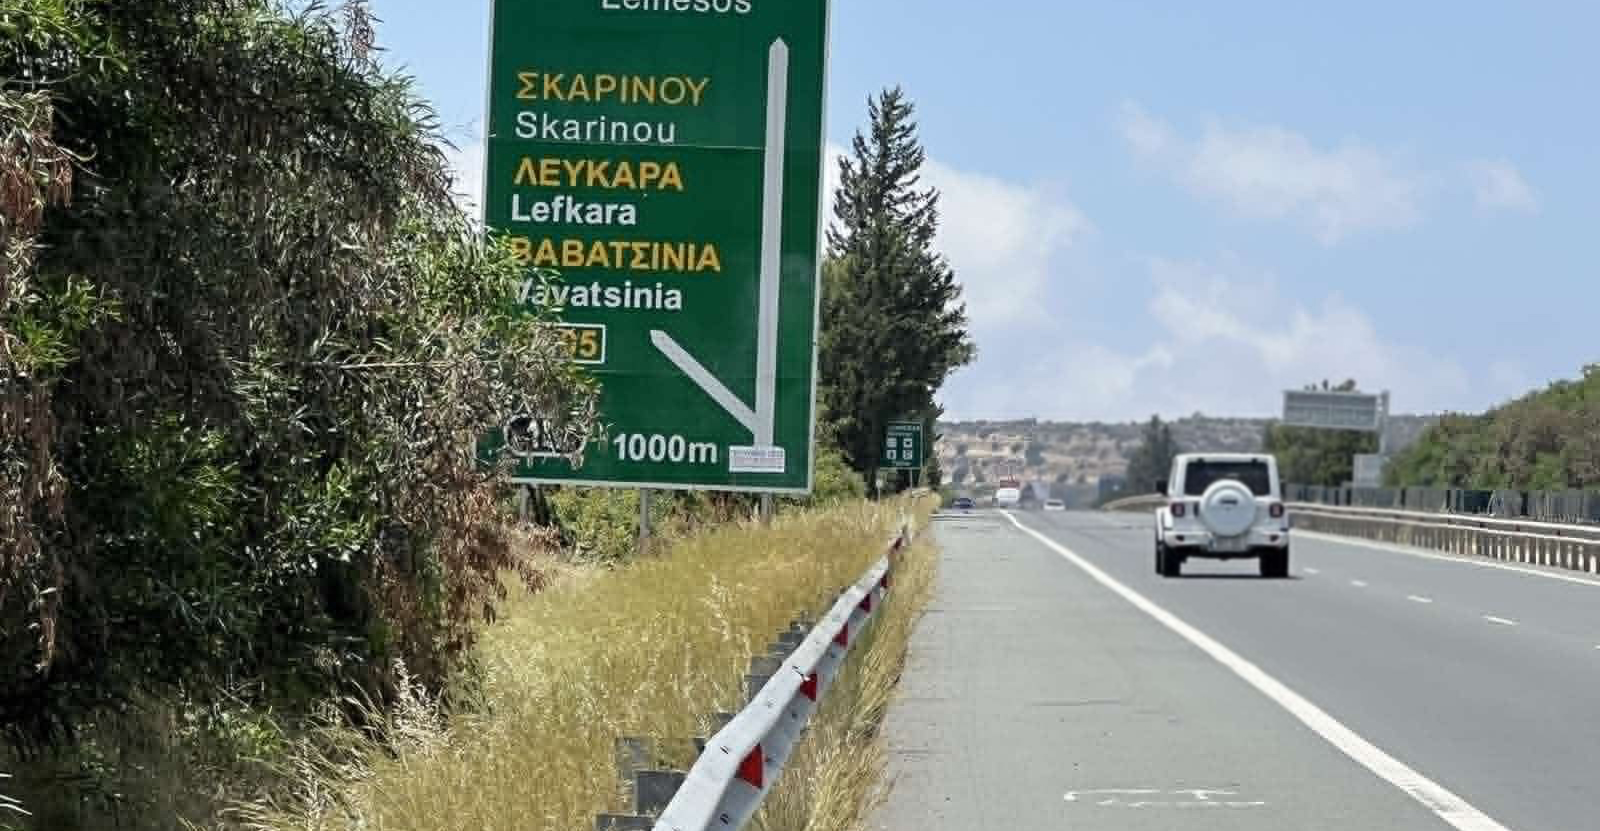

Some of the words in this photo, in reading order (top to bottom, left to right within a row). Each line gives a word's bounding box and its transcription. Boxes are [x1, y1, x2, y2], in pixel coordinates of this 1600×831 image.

[515, 71, 710, 107] ΣΚΑΡΙΝΟΥ
[515, 110, 676, 143] Skarinou
[513, 157, 684, 192] ΛΕΥΚΑΡΑ
[511, 193, 637, 226] Lefkara
[510, 236, 721, 272] ΒΑΒΑΤΣΙΝΙΑ
[612, 433, 718, 463] 1000m
